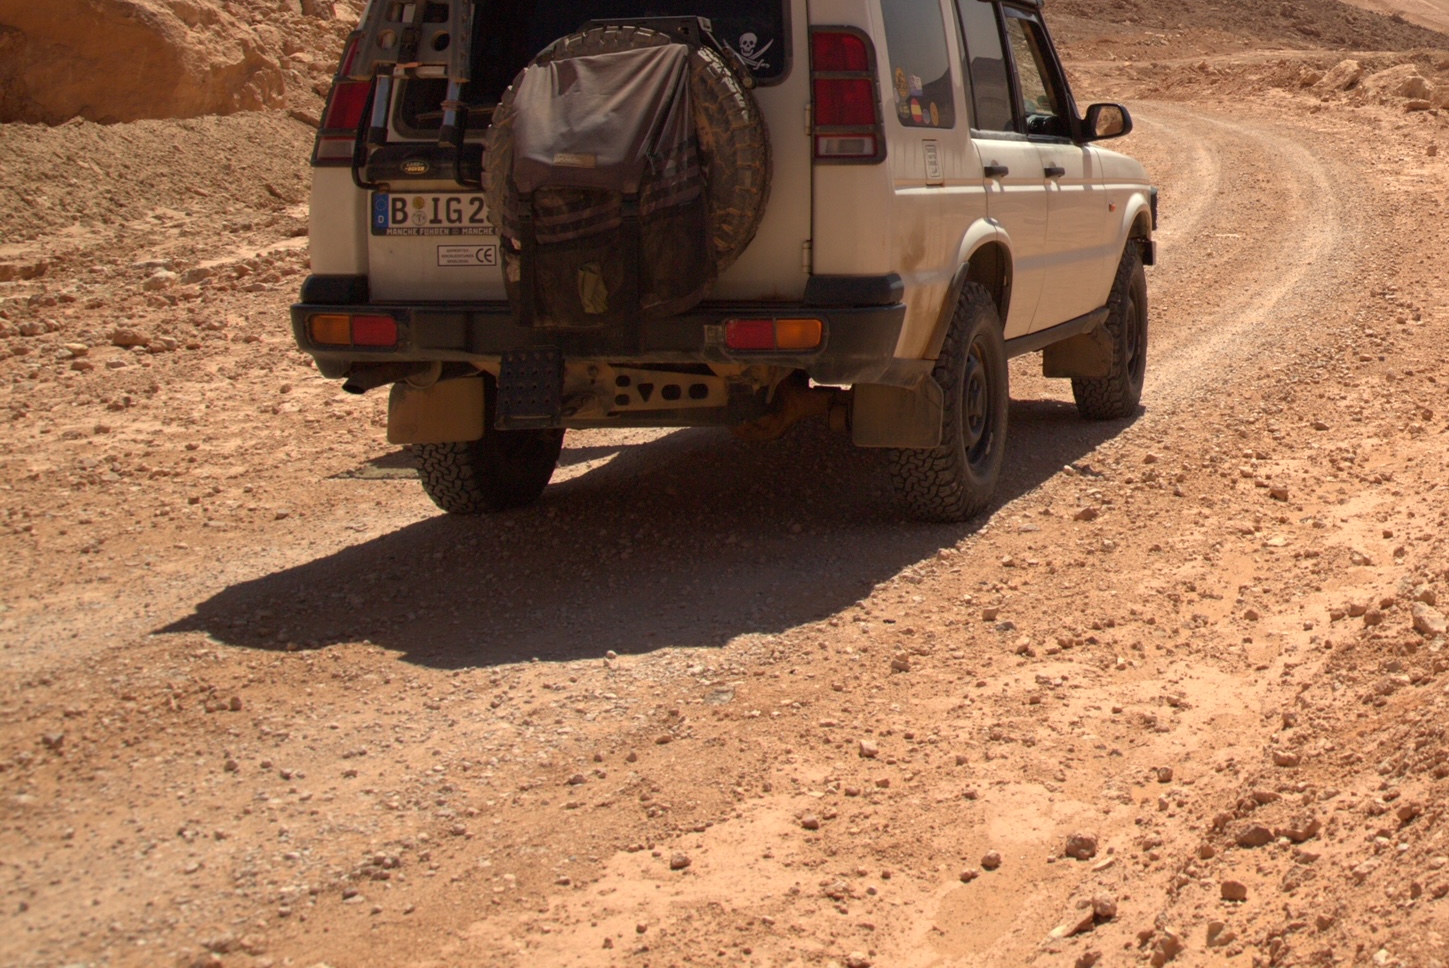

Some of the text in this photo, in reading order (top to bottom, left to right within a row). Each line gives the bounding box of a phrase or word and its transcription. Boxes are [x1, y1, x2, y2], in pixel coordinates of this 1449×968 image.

[391, 197, 408, 225] B
[378, 215, 384, 224] D
[386, 228, 418, 236] MANCHE
[462, 228, 494, 236] MANCHE
